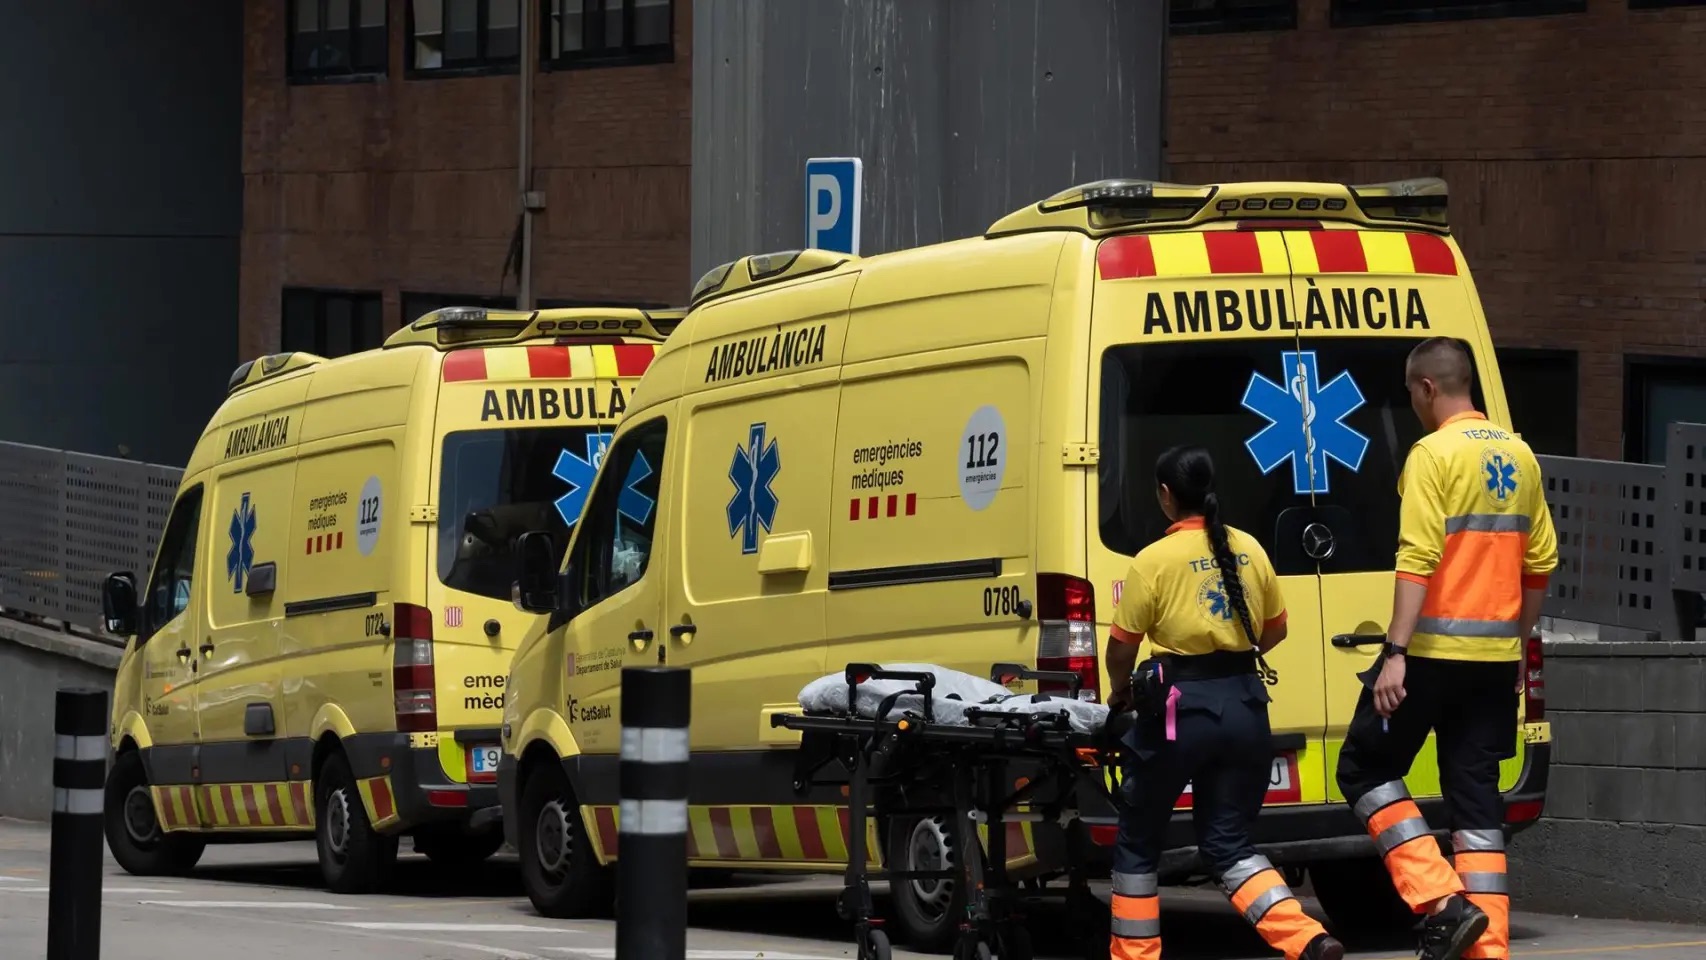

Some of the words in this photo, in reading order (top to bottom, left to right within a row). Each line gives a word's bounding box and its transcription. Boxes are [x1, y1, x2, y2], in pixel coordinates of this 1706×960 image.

[809, 173, 841, 250] P
[1143, 278, 1430, 334] AMBULÀNCIA
[704, 325, 826, 383] AMBULÀNCIA
[481, 380, 636, 421] AMBULÀ
[224, 414, 290, 459] AMBULÀNCIA
[966, 432, 999, 468] 112
[853, 438, 922, 467] emergències
[852, 468, 904, 491] mèdiques
[309, 489, 348, 511] emergències
[361, 496, 379, 525] 112
[308, 514, 337, 531] mèdiques
[1189, 554, 1249, 572] TÈCC
[984, 585, 1019, 616] 0780
[581, 705, 611, 721] CatSalut
[487, 750, 498, 767] 9
